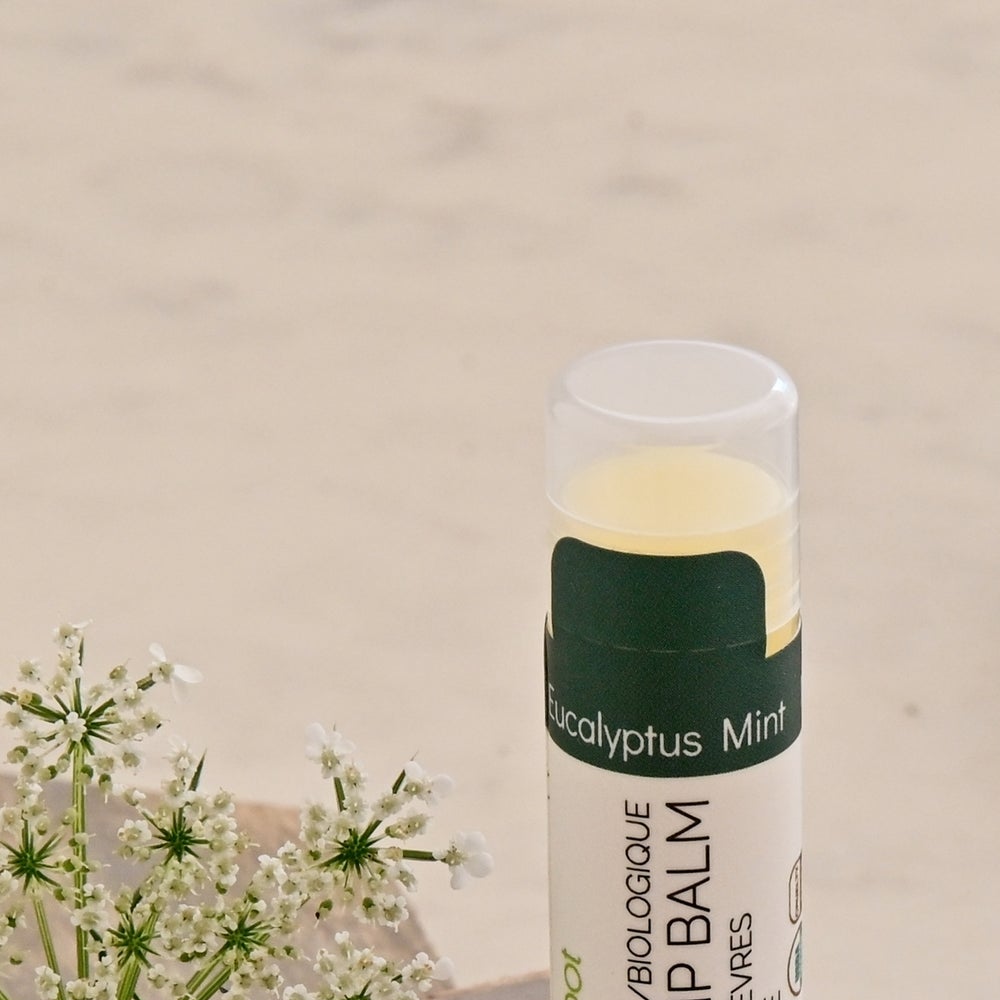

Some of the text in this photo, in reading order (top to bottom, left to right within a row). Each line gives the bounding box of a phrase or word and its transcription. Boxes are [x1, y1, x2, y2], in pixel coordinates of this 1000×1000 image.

[548, 682, 787, 762] Eucalyptus Mint
[665, 800, 711, 946] BALM
